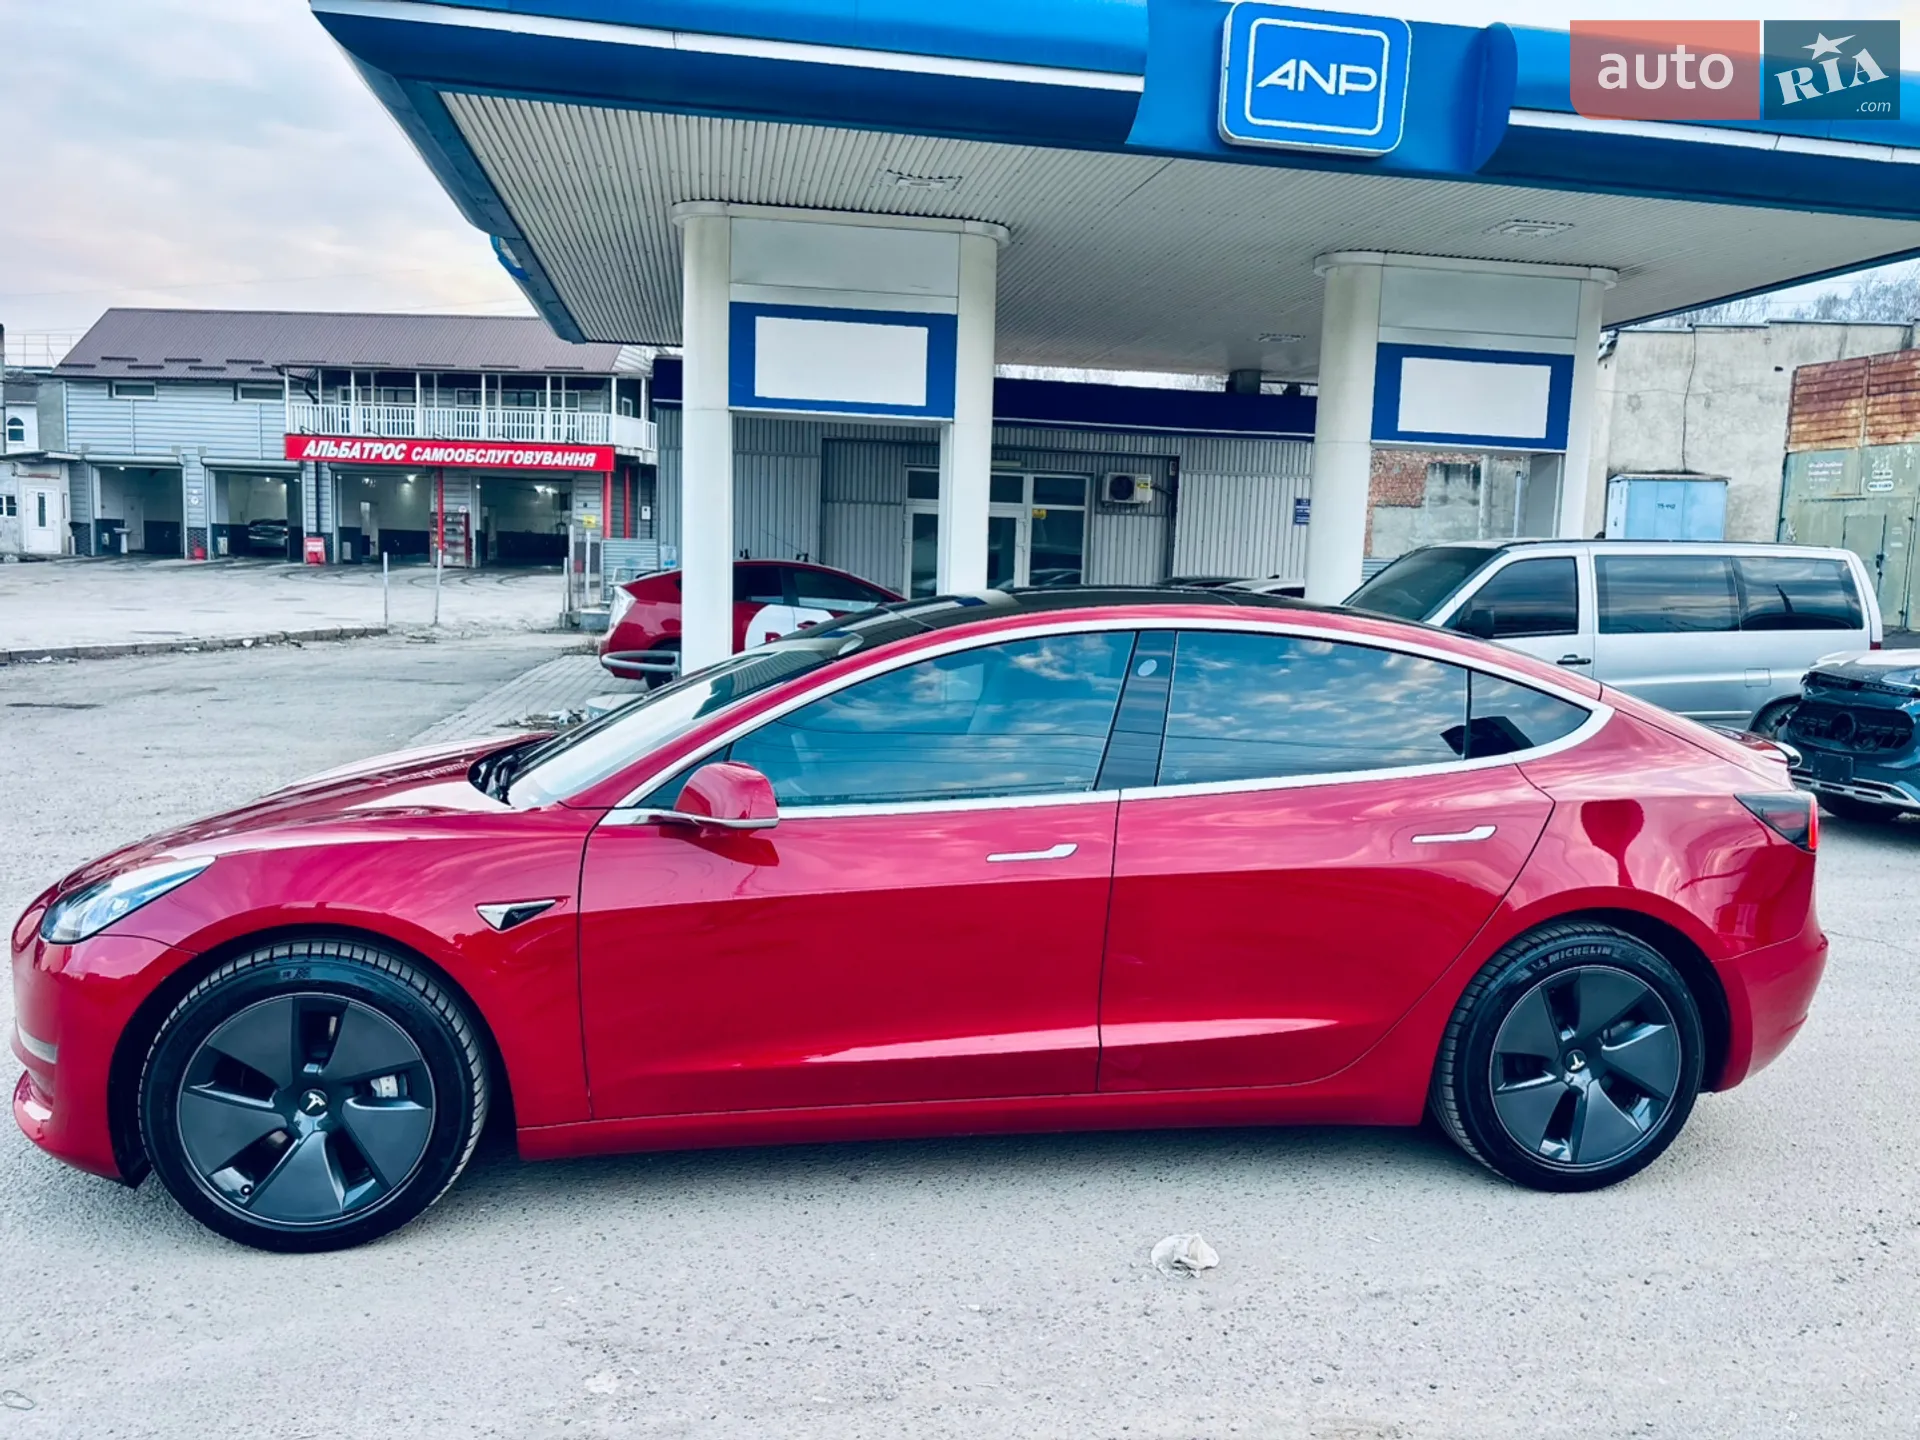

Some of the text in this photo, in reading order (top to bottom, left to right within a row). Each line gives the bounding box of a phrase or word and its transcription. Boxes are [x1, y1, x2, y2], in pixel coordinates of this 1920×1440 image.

[1256, 58, 1378, 96] ANP
[302, 440, 596, 467] АЛЬБАТРОС САМООБСЛУГОВУВАННЯ
[1549, 946, 1612, 963] MICHELIN
